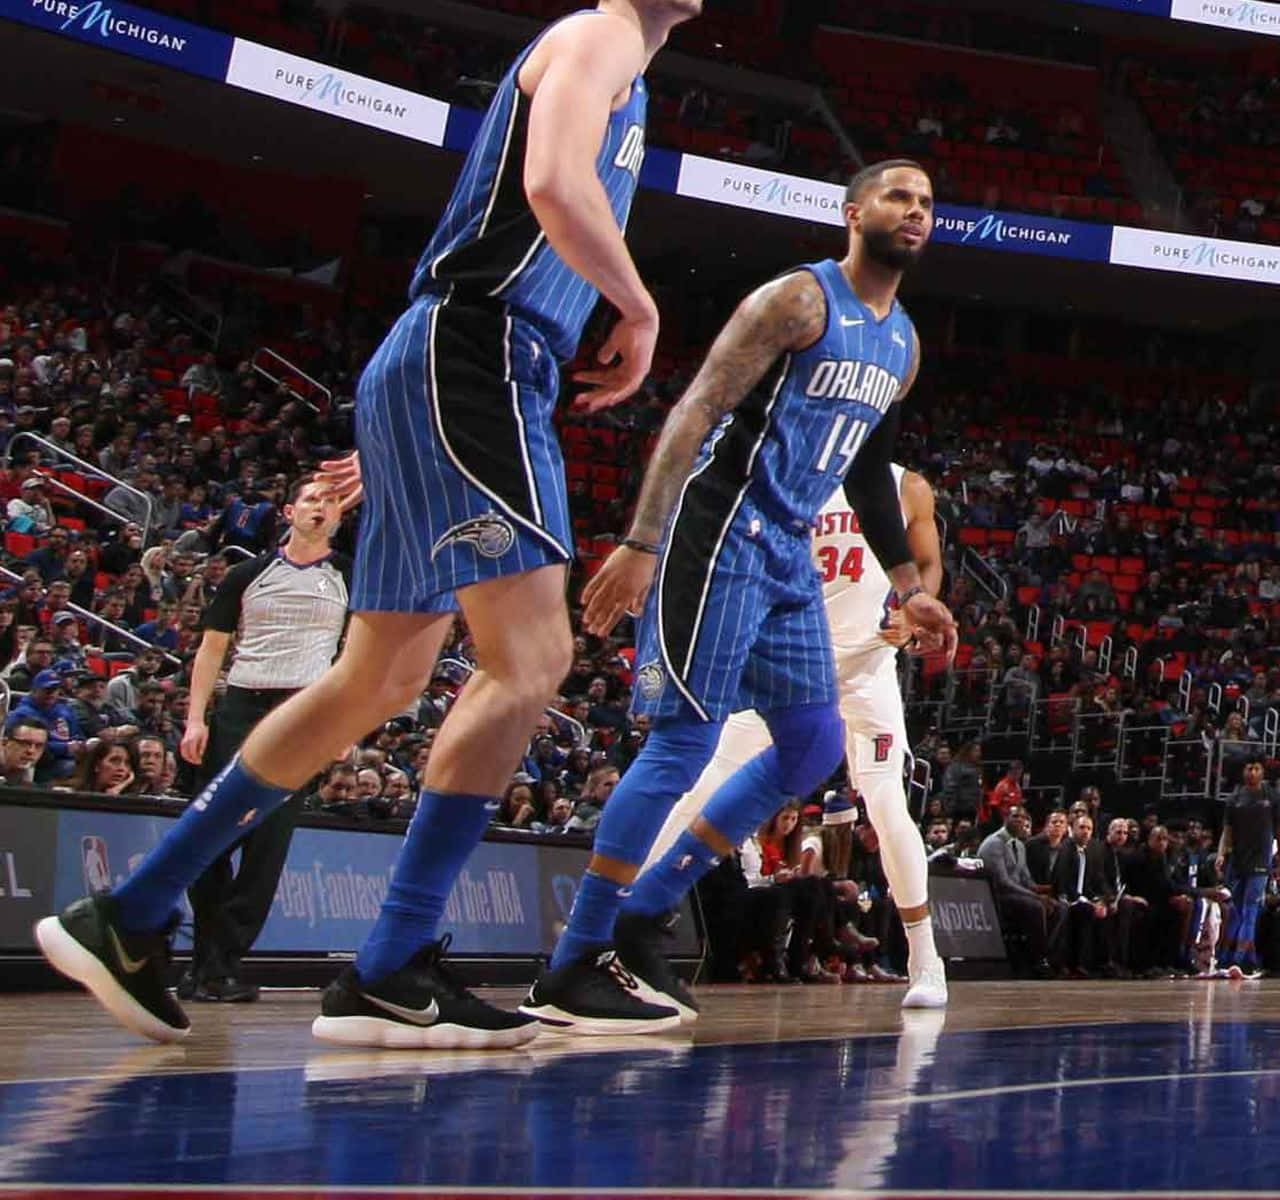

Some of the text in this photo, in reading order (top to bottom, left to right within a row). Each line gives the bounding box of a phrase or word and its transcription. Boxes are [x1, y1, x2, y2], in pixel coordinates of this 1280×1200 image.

[61, 0, 187, 51] MICHIGAN
[1202, 3, 1234, 18] PURE
[275, 69, 407, 117] PURE MICHIGAN
[722, 177, 842, 211] PURE MICHIGA
[935, 213, 1071, 244] PURE MICHIGAN
[1153, 243, 1279, 271] PURE MICHIGAN
[806, 360, 900, 415] ORLAND
[816, 413, 869, 476] 14
[817, 546, 865, 582] 34
[932, 902, 993, 931] ANDUEL
